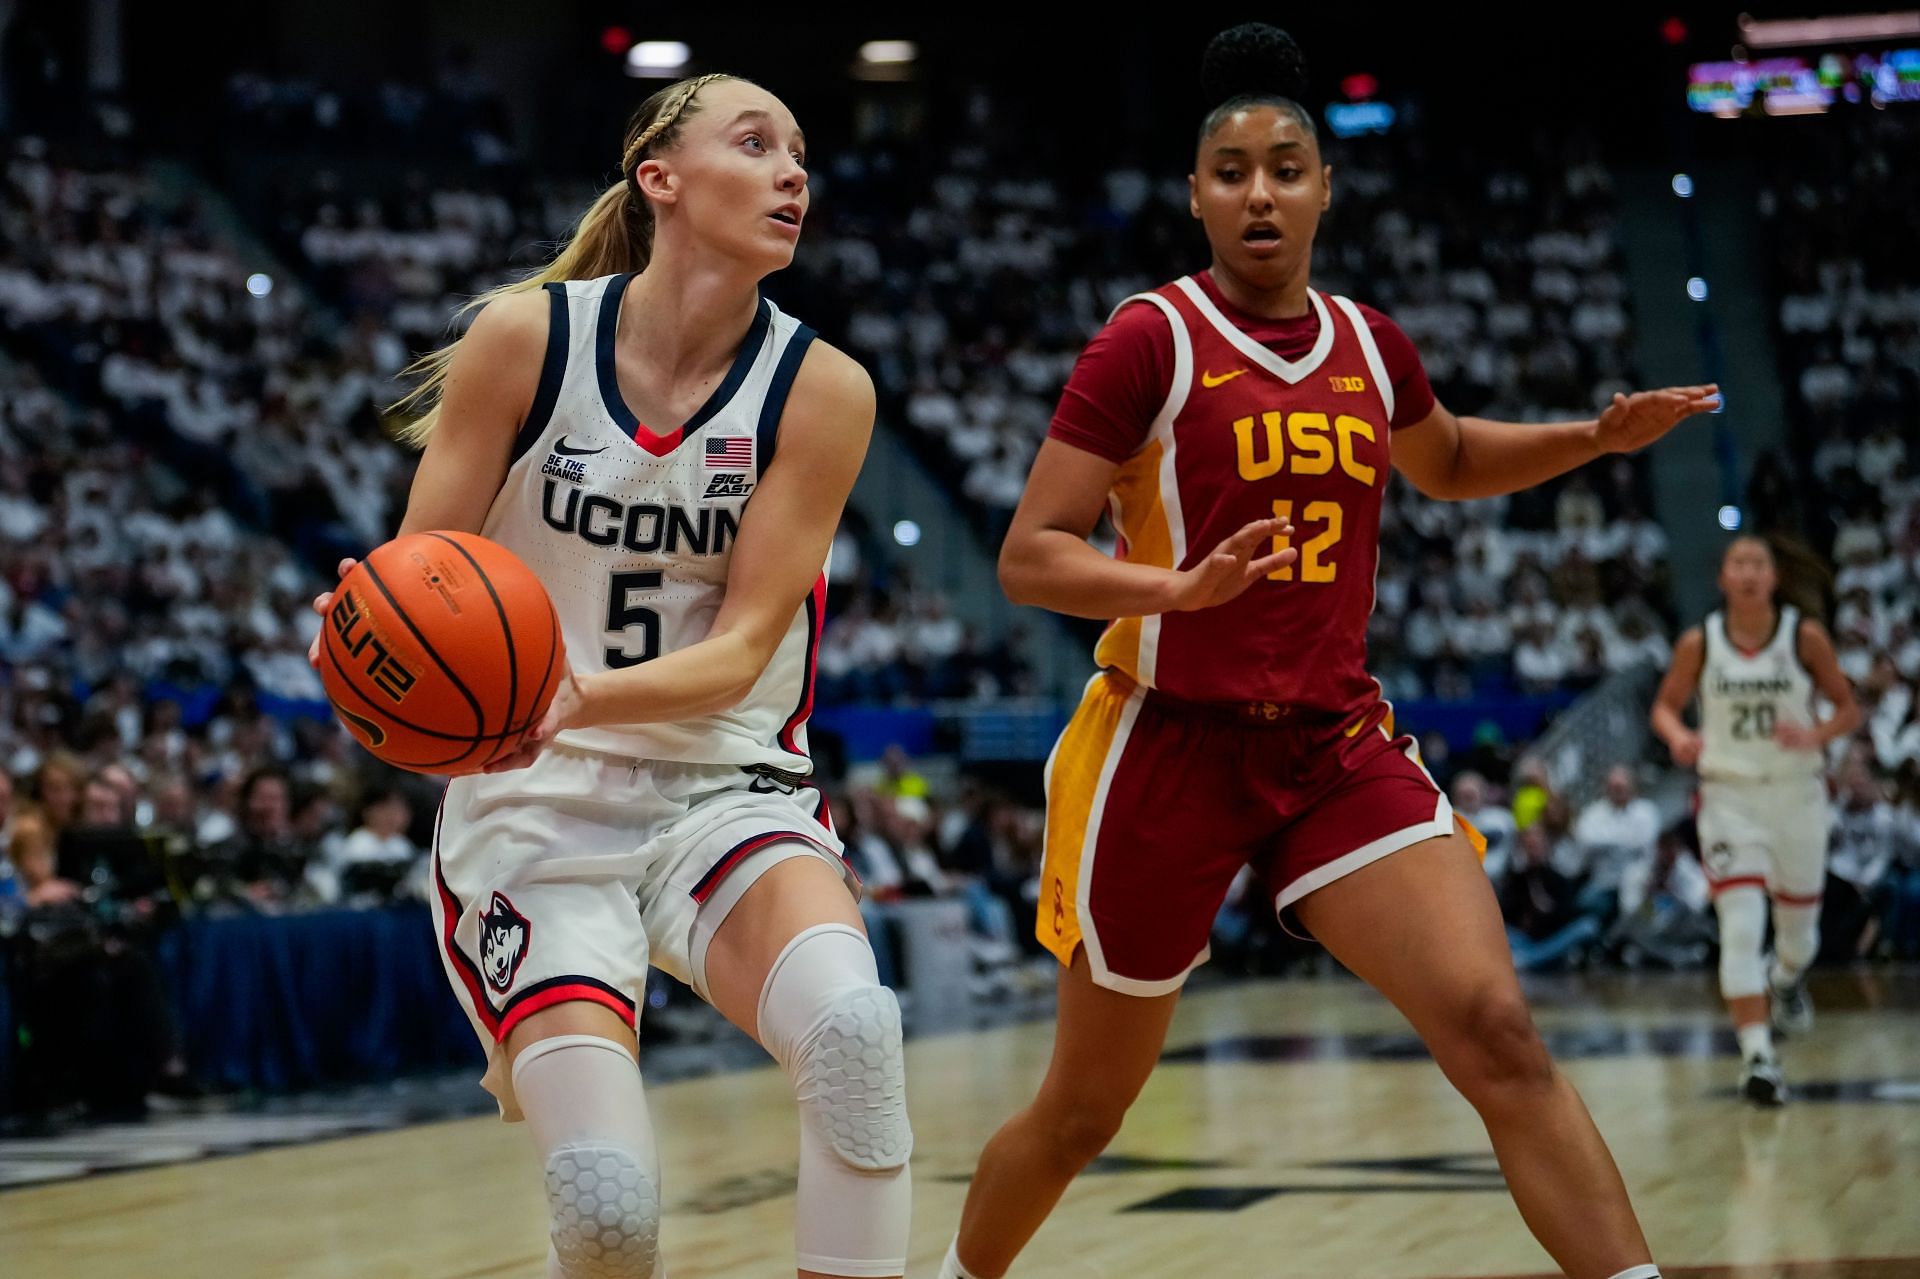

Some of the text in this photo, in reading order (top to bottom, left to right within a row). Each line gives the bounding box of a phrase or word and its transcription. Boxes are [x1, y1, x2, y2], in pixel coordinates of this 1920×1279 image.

[541, 464, 584, 483] CHANGE
[547, 454, 587, 472] BE THE
[1233, 411, 1376, 487] USC
[705, 484, 754, 493] EAST
[711, 474, 746, 484] BIG
[541, 480, 743, 555] UCONN
[1267, 500, 1343, 583] 12
[332, 589, 417, 704] ELITE
[604, 570, 664, 669] 5
[1730, 702, 1776, 740] 20
